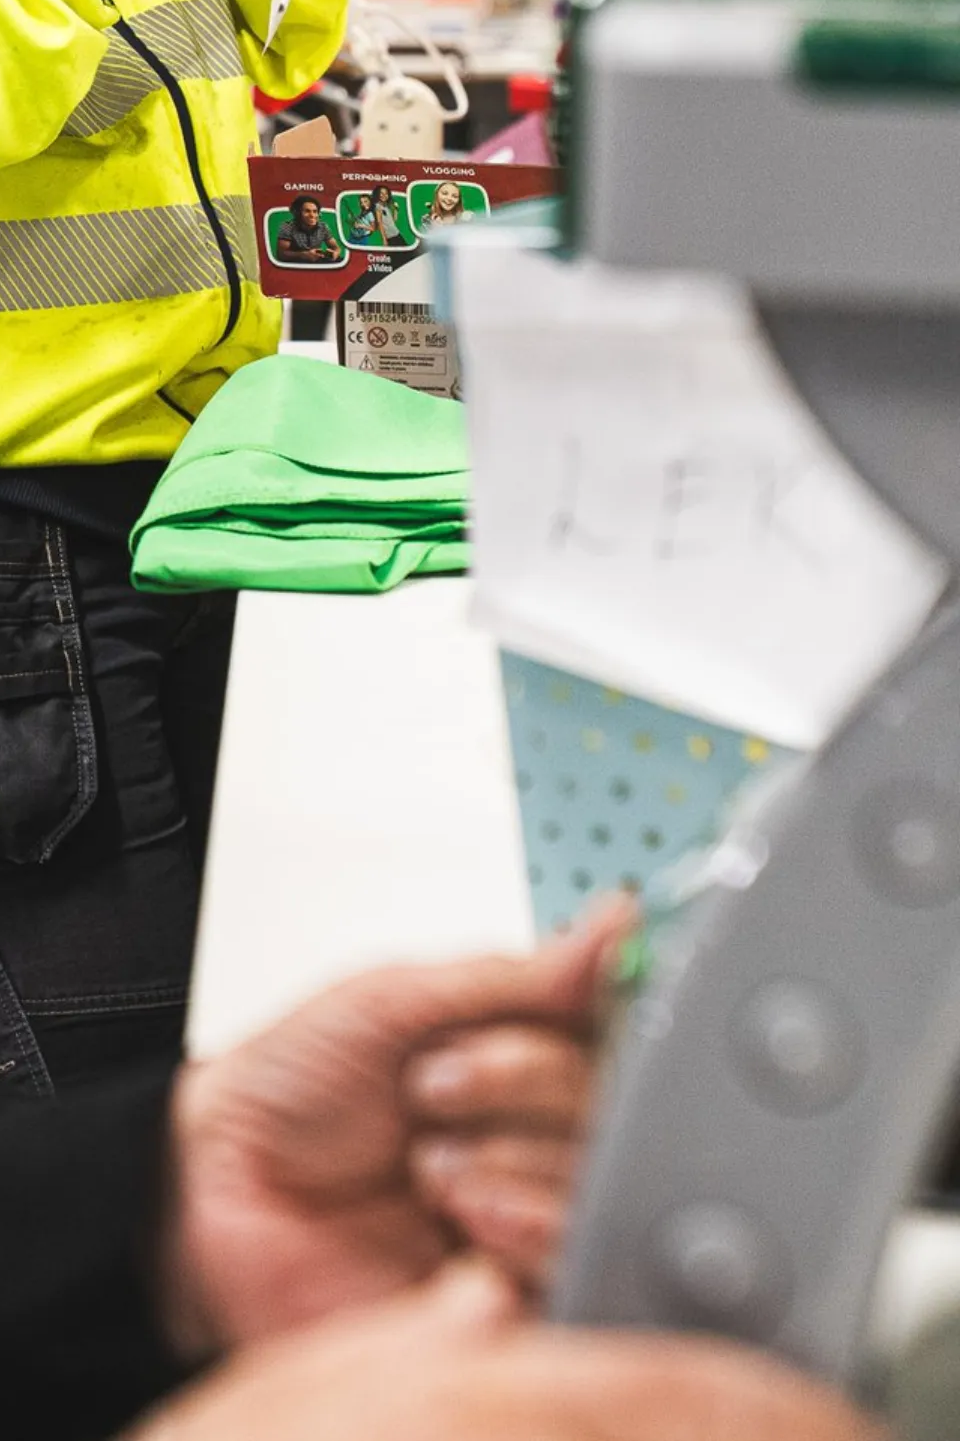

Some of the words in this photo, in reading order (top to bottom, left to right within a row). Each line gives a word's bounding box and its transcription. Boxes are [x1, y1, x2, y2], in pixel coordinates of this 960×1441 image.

[422, 165, 476, 176] VLOGGING
[341, 172, 408, 183] PERFORMING
[283, 182, 325, 192] GAMING
[367, 253, 392, 264] Create
[373, 263, 393, 273] Video
[348, 314, 354, 322] 5
